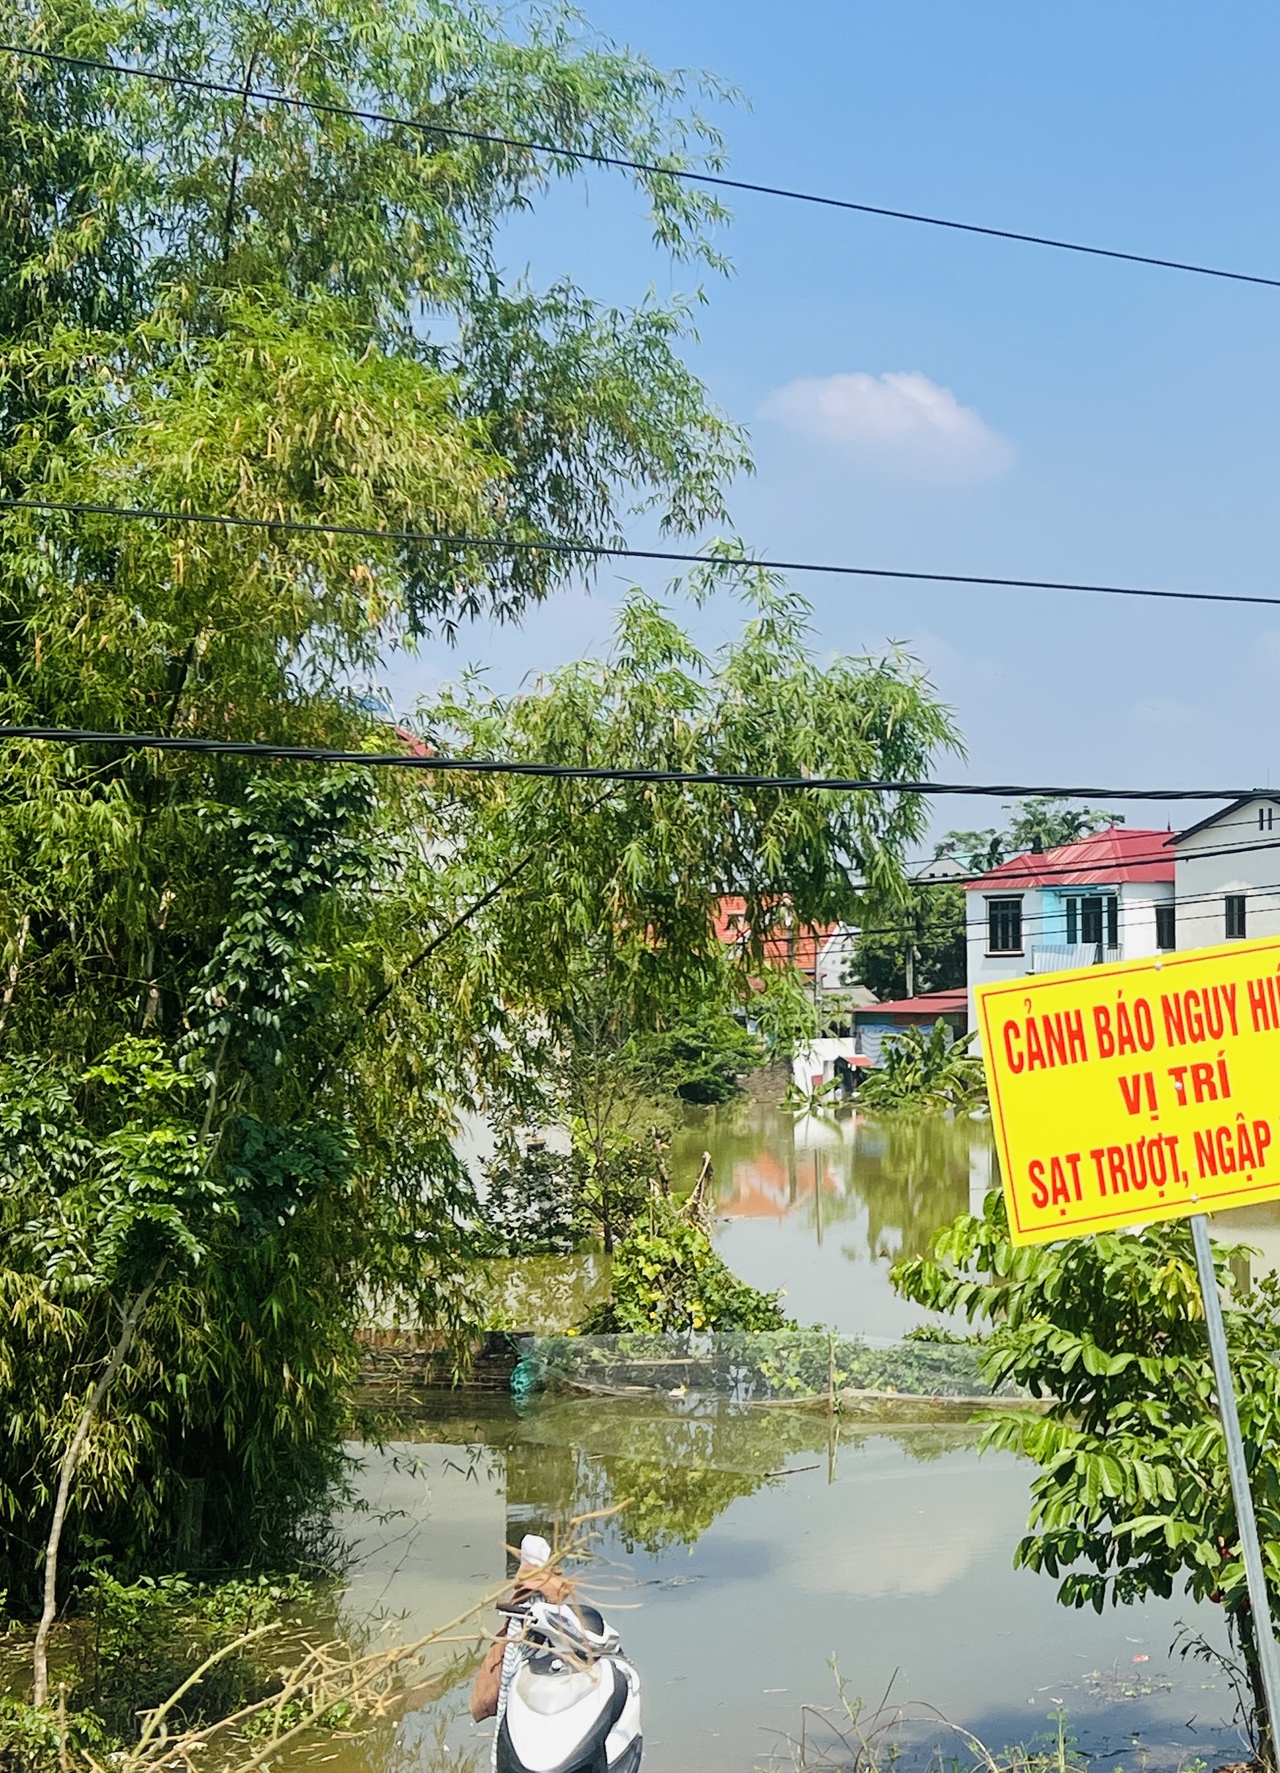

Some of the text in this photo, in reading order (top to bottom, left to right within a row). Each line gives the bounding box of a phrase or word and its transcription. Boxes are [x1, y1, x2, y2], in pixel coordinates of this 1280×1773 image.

[1003, 997, 1088, 1075] CẢNH
[1093, 989, 1155, 1059] BÁO
[1160, 983, 1239, 1048] NGUY
[1117, 1050, 1231, 1121] VỊ TRÍ
[1028, 1152, 1083, 1216] SẠT
[1090, 1132, 1189, 1198] TRƯỢT,
[1193, 1113, 1271, 1182] NGẬP
